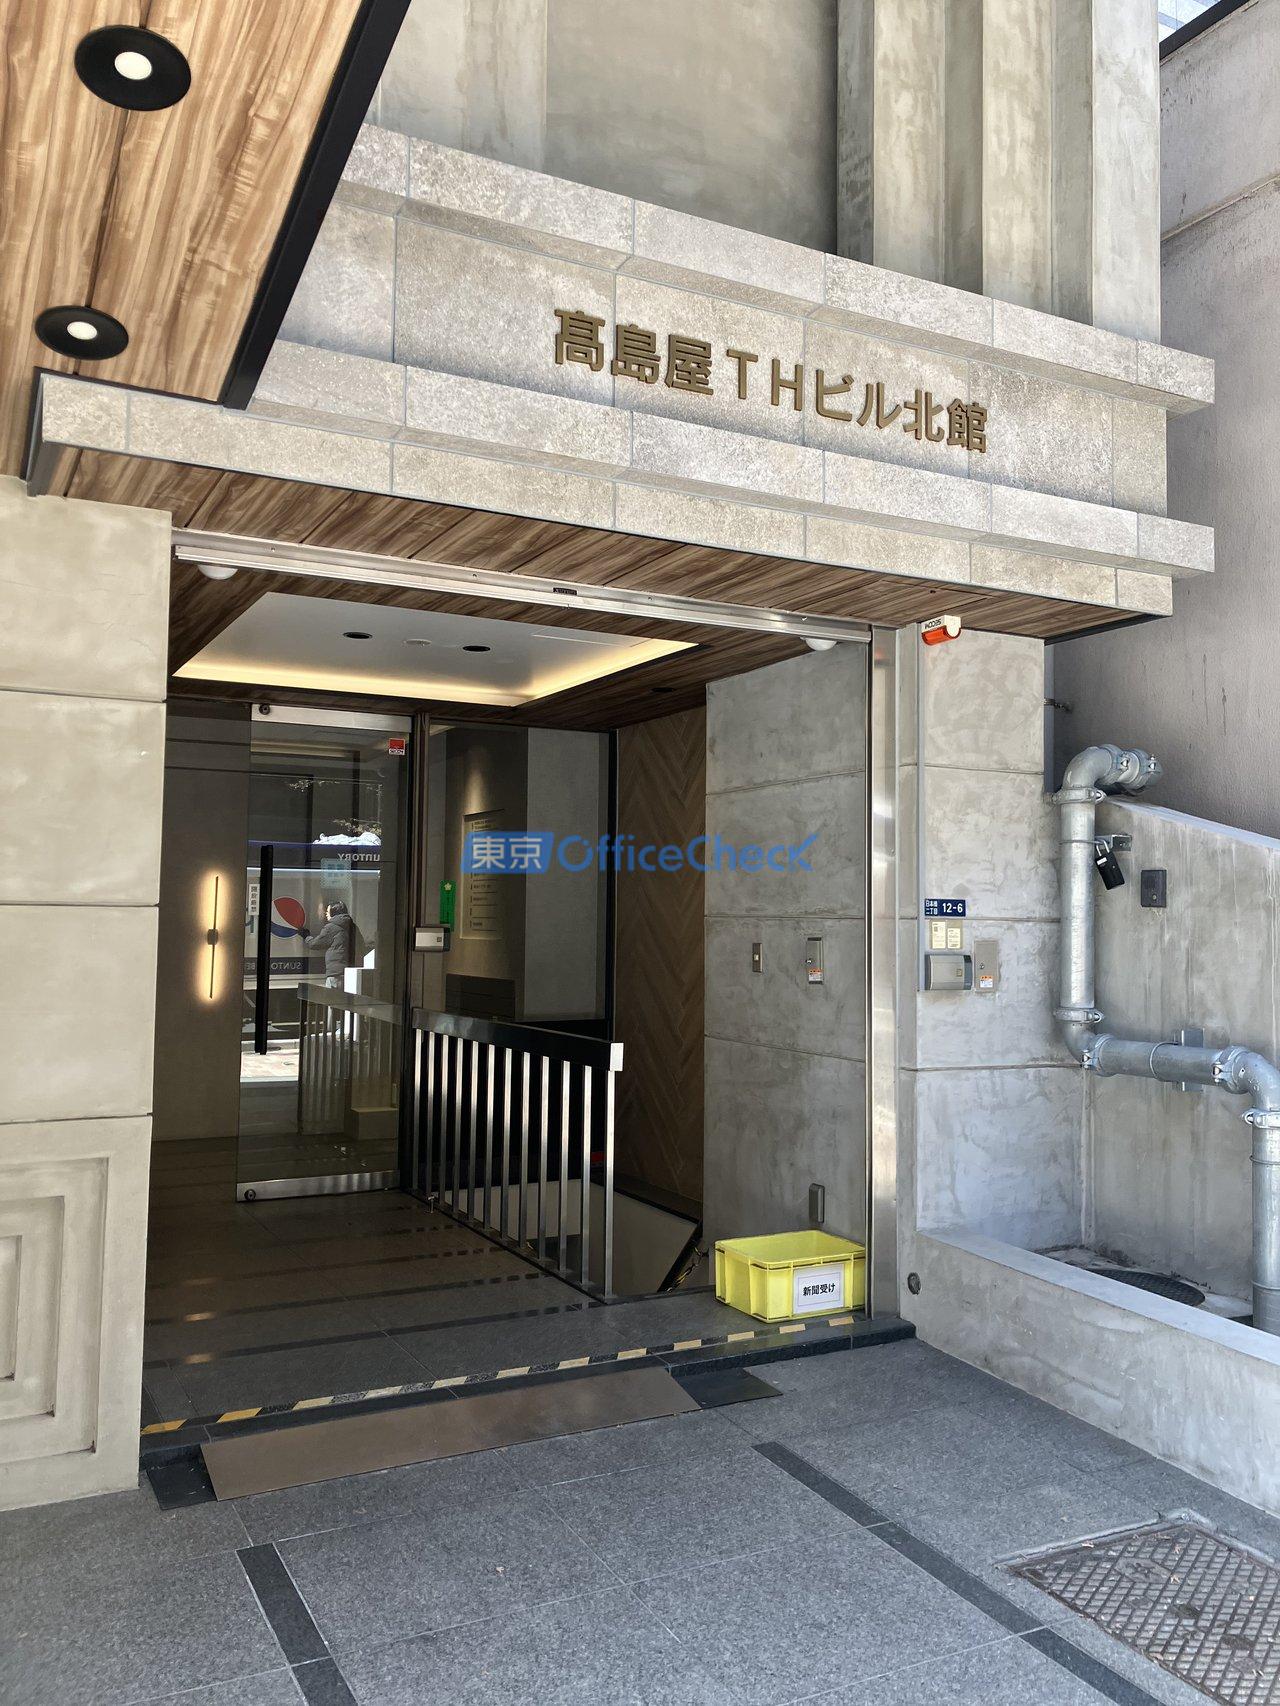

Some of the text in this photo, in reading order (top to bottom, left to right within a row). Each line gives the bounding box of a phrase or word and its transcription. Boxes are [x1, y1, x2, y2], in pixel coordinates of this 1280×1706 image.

[942, 902, 963, 913] 12-6
[802, 1282, 836, 1297] 新聞受け
